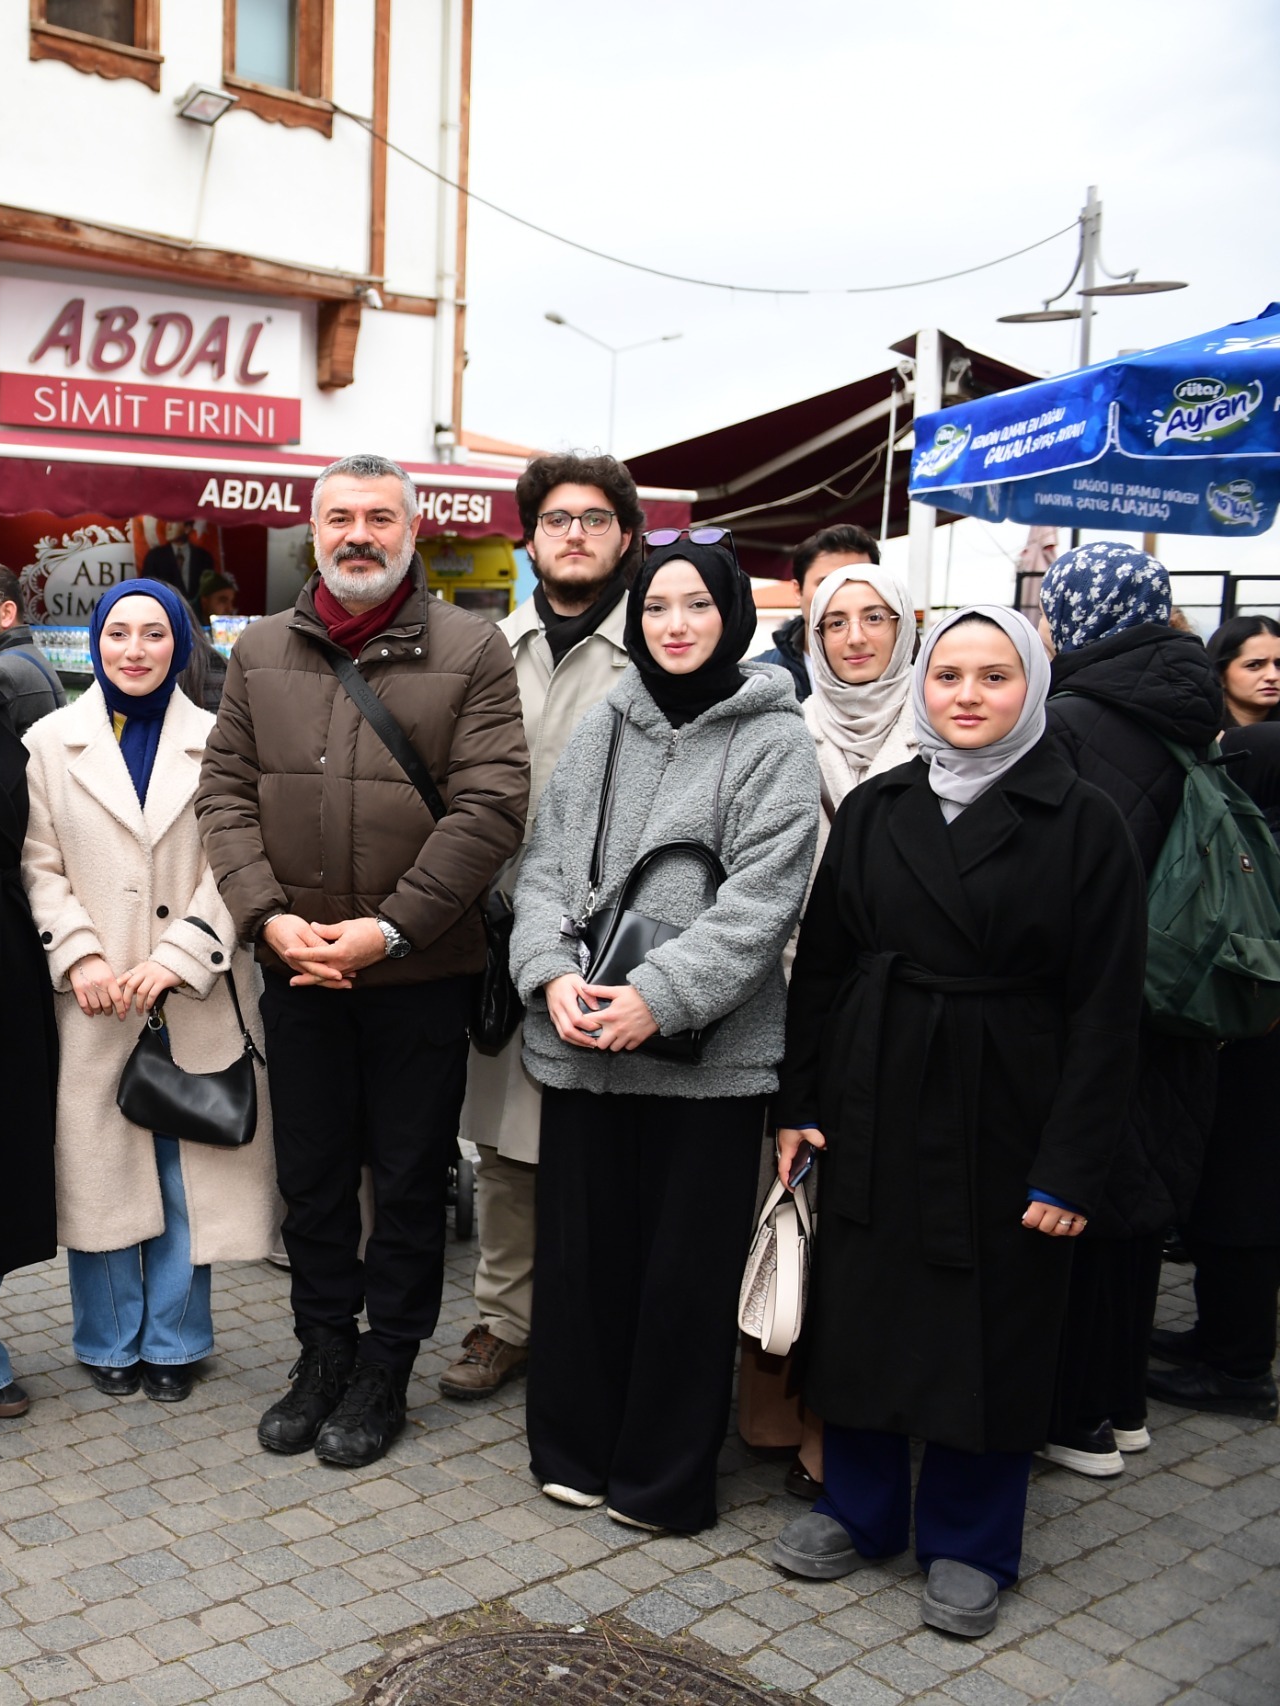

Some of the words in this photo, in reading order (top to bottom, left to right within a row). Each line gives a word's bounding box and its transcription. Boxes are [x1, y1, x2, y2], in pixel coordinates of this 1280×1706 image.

[28, 297, 271, 386] ABDAL
[33, 381, 148, 428] SİMİT
[164, 397, 275, 438] FIRINI
[1166, 393, 1248, 437] Ayran
[198, 478, 301, 512] ABDAL
[418, 491, 492, 525] HÇESİ
[51, 591, 96, 616] SİM
